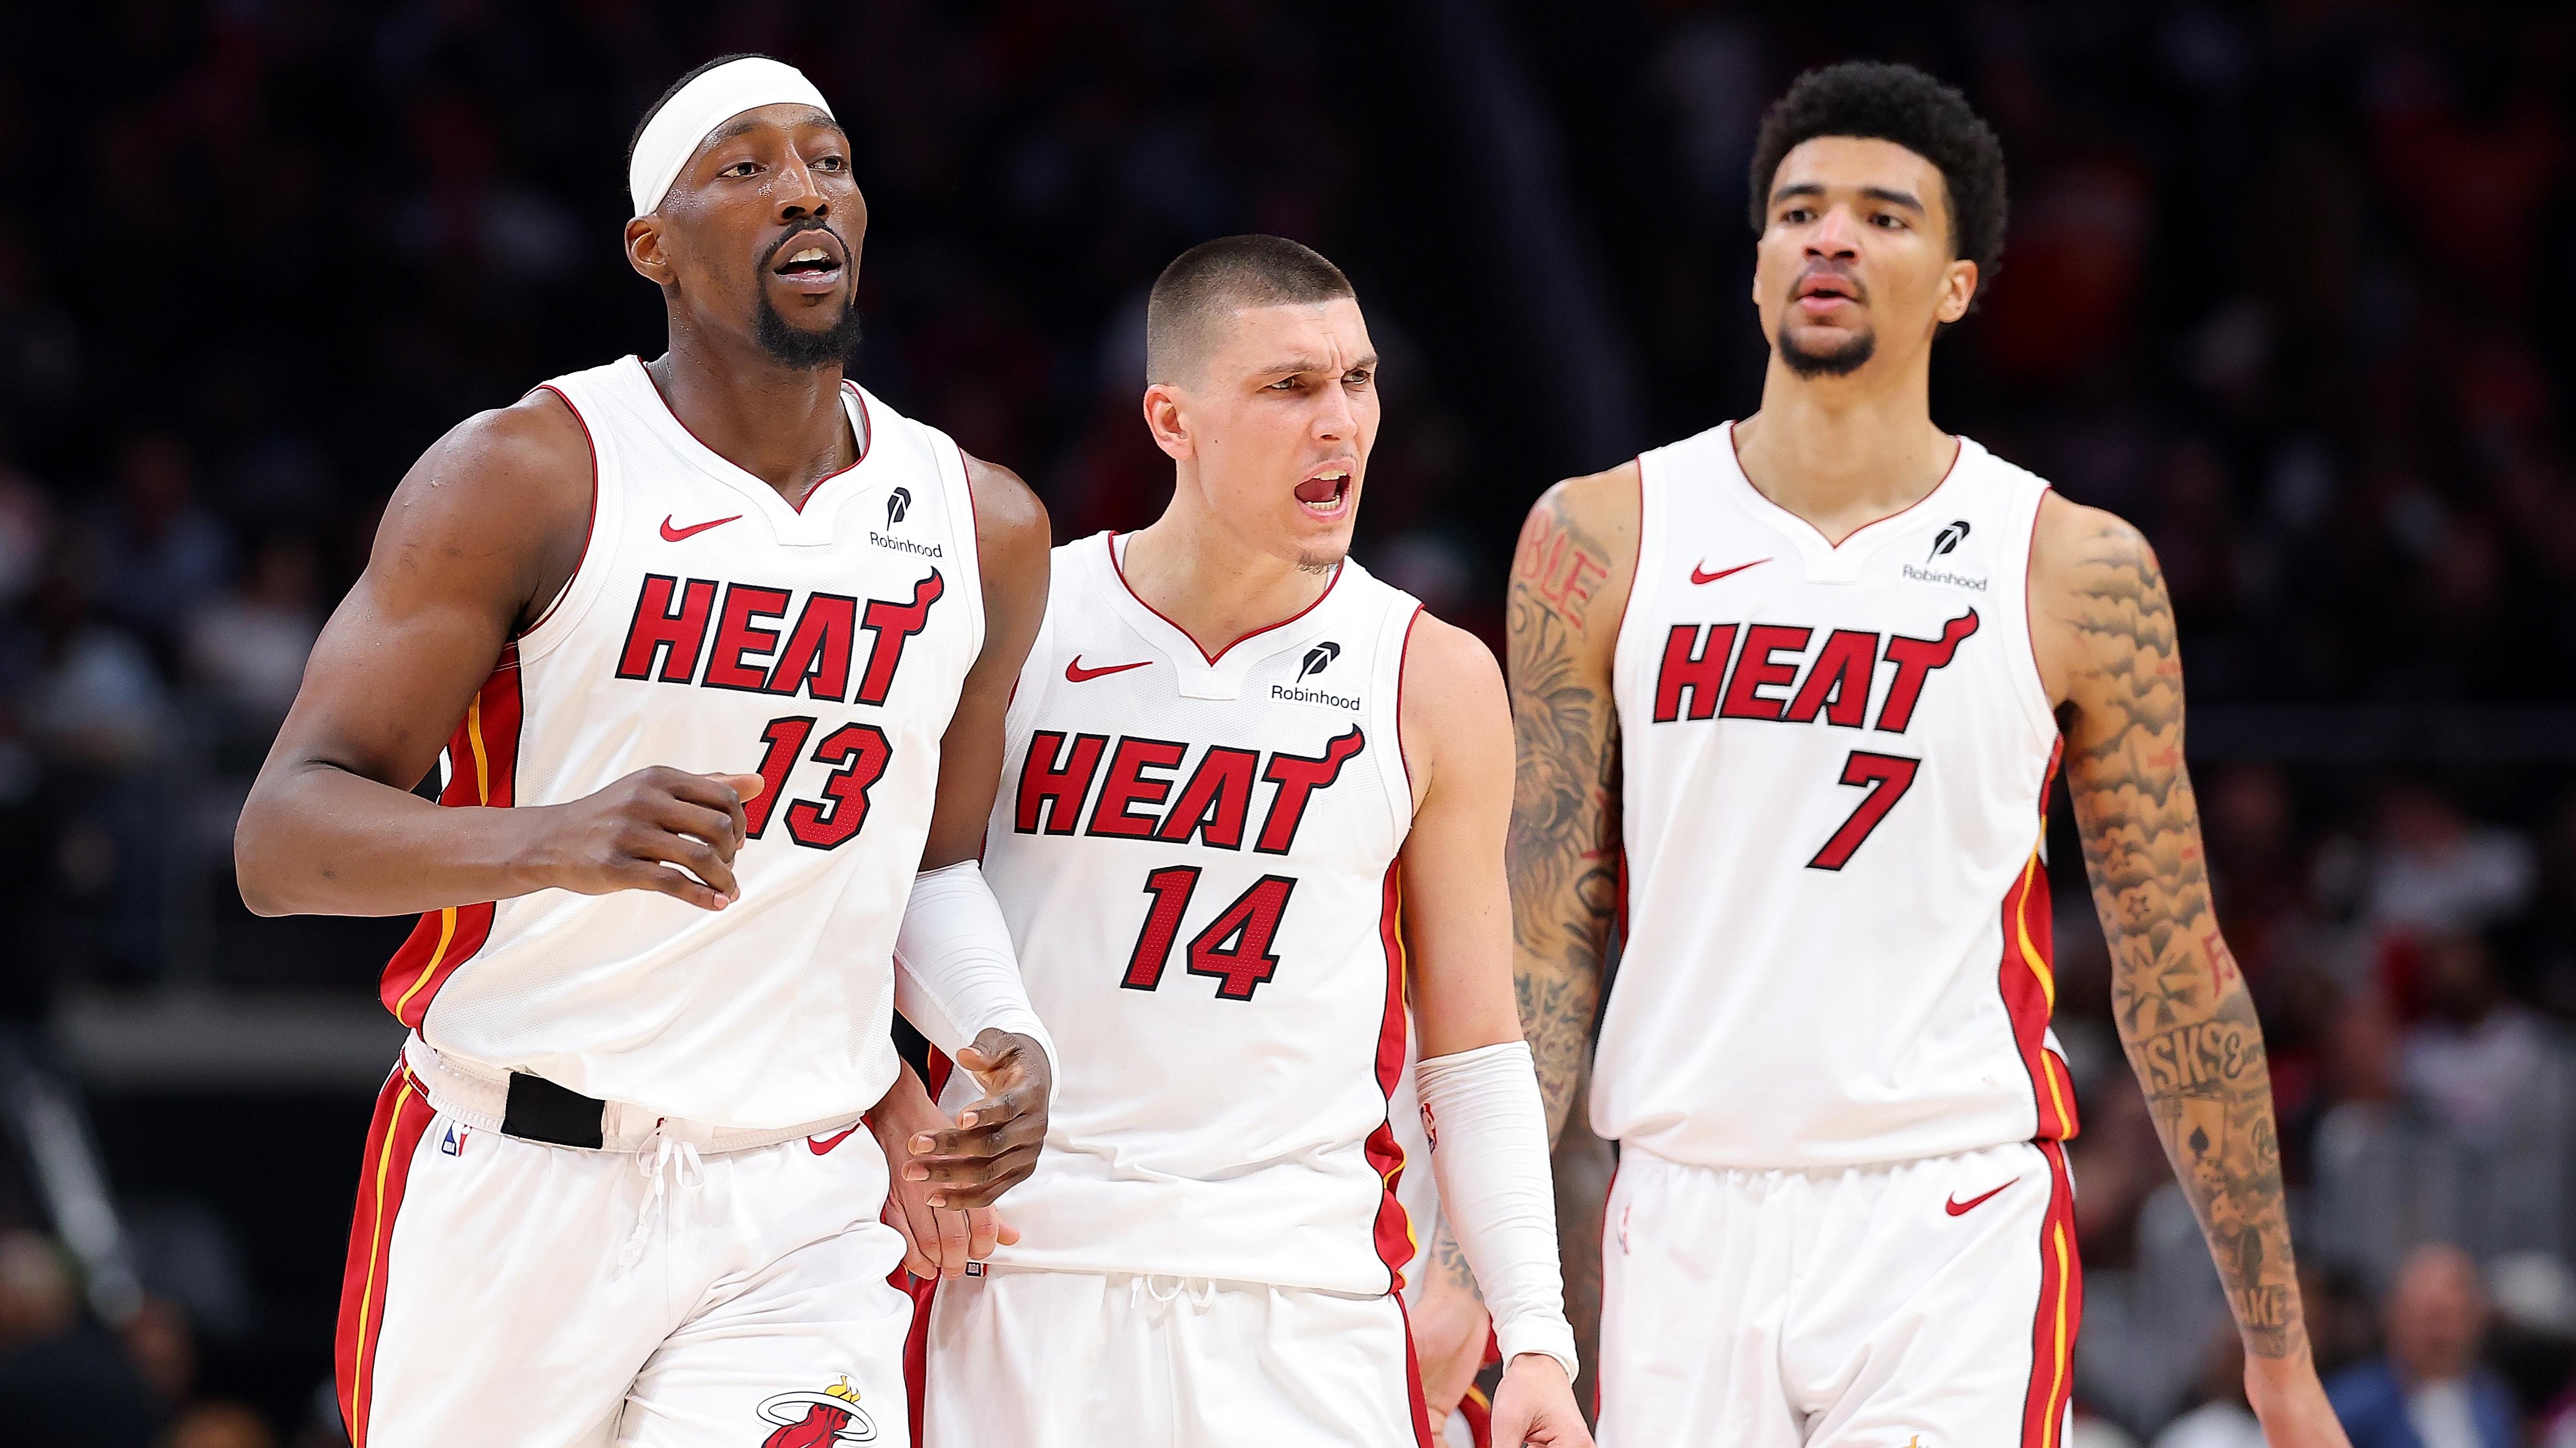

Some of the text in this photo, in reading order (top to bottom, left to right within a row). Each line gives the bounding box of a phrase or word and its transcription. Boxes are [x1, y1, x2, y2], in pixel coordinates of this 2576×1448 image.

[870, 531, 943, 558] Robinhood
[1902, 563, 1988, 592] Robinhood
[615, 566, 944, 706] HEAT
[1271, 685, 1360, 711] Robinhood
[1653, 607, 1979, 734] HEAT
[740, 715, 893, 851] 13
[1014, 723, 1365, 855] HEAT
[1805, 750, 1921, 871] 7
[1120, 865, 1297, 1001] 14
